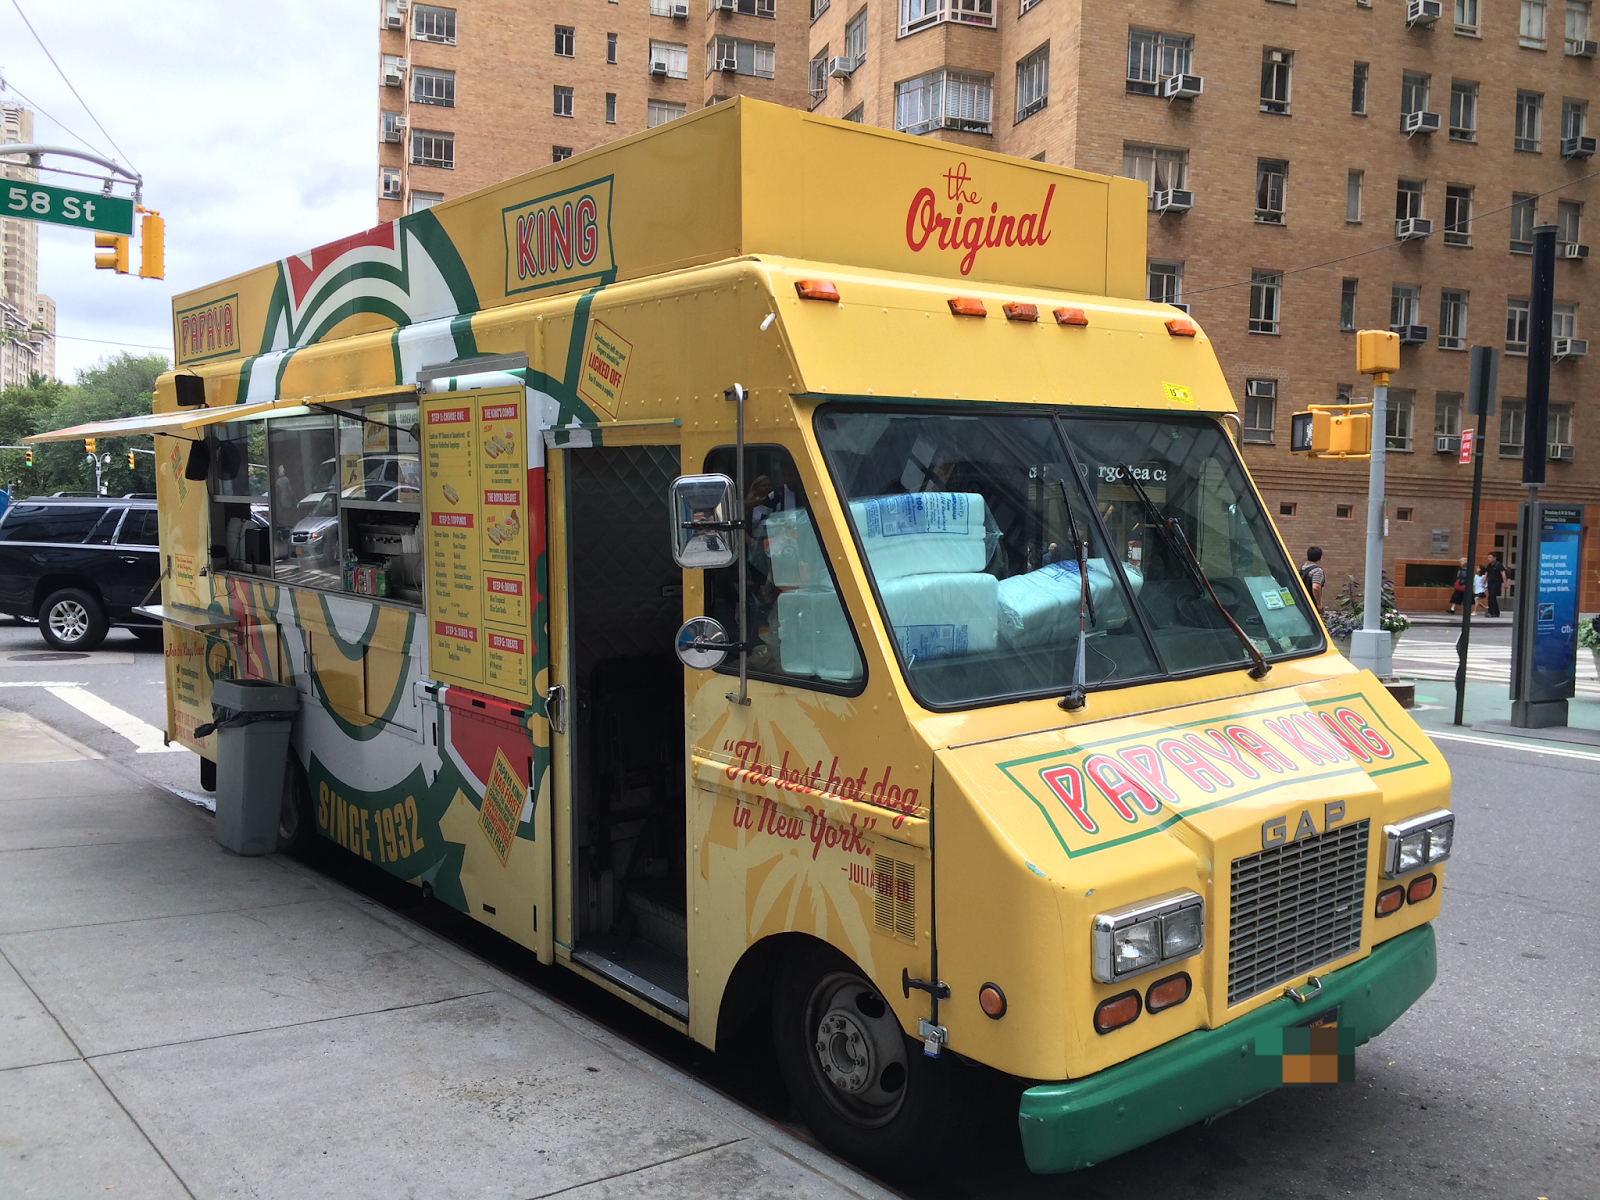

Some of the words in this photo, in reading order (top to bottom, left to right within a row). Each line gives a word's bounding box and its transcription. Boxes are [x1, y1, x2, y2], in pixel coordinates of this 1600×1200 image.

[8, 187, 50, 214] 58
[62, 197, 96, 222] St
[943, 162, 982, 204] the
[516, 195, 598, 281] KING
[906, 183, 1056, 276] Original
[181, 303, 234, 357] PAPAYA
[588, 352, 610, 380] LICKED
[609, 368, 622, 388] OFF
[432, 412, 440, 422] STEP
[439, 515, 447, 524] STEP
[446, 625, 454, 634] STEP
[494, 636, 502, 646] STEP
[494, 768, 506, 795] WAS
[504, 786, 520, 816] FIRST
[775, 750, 822, 794] best
[818, 756, 868, 803] hot
[869, 765, 922, 830] dog
[1038, 724, 1299, 835] PAPAYA
[1262, 706, 1394, 768] KING
[318, 780, 372, 862] SINCE
[374, 795, 425, 863] 1932
[733, 798, 753, 830] in
[756, 795, 806, 841] New
[1260, 799, 1346, 850] GAP
